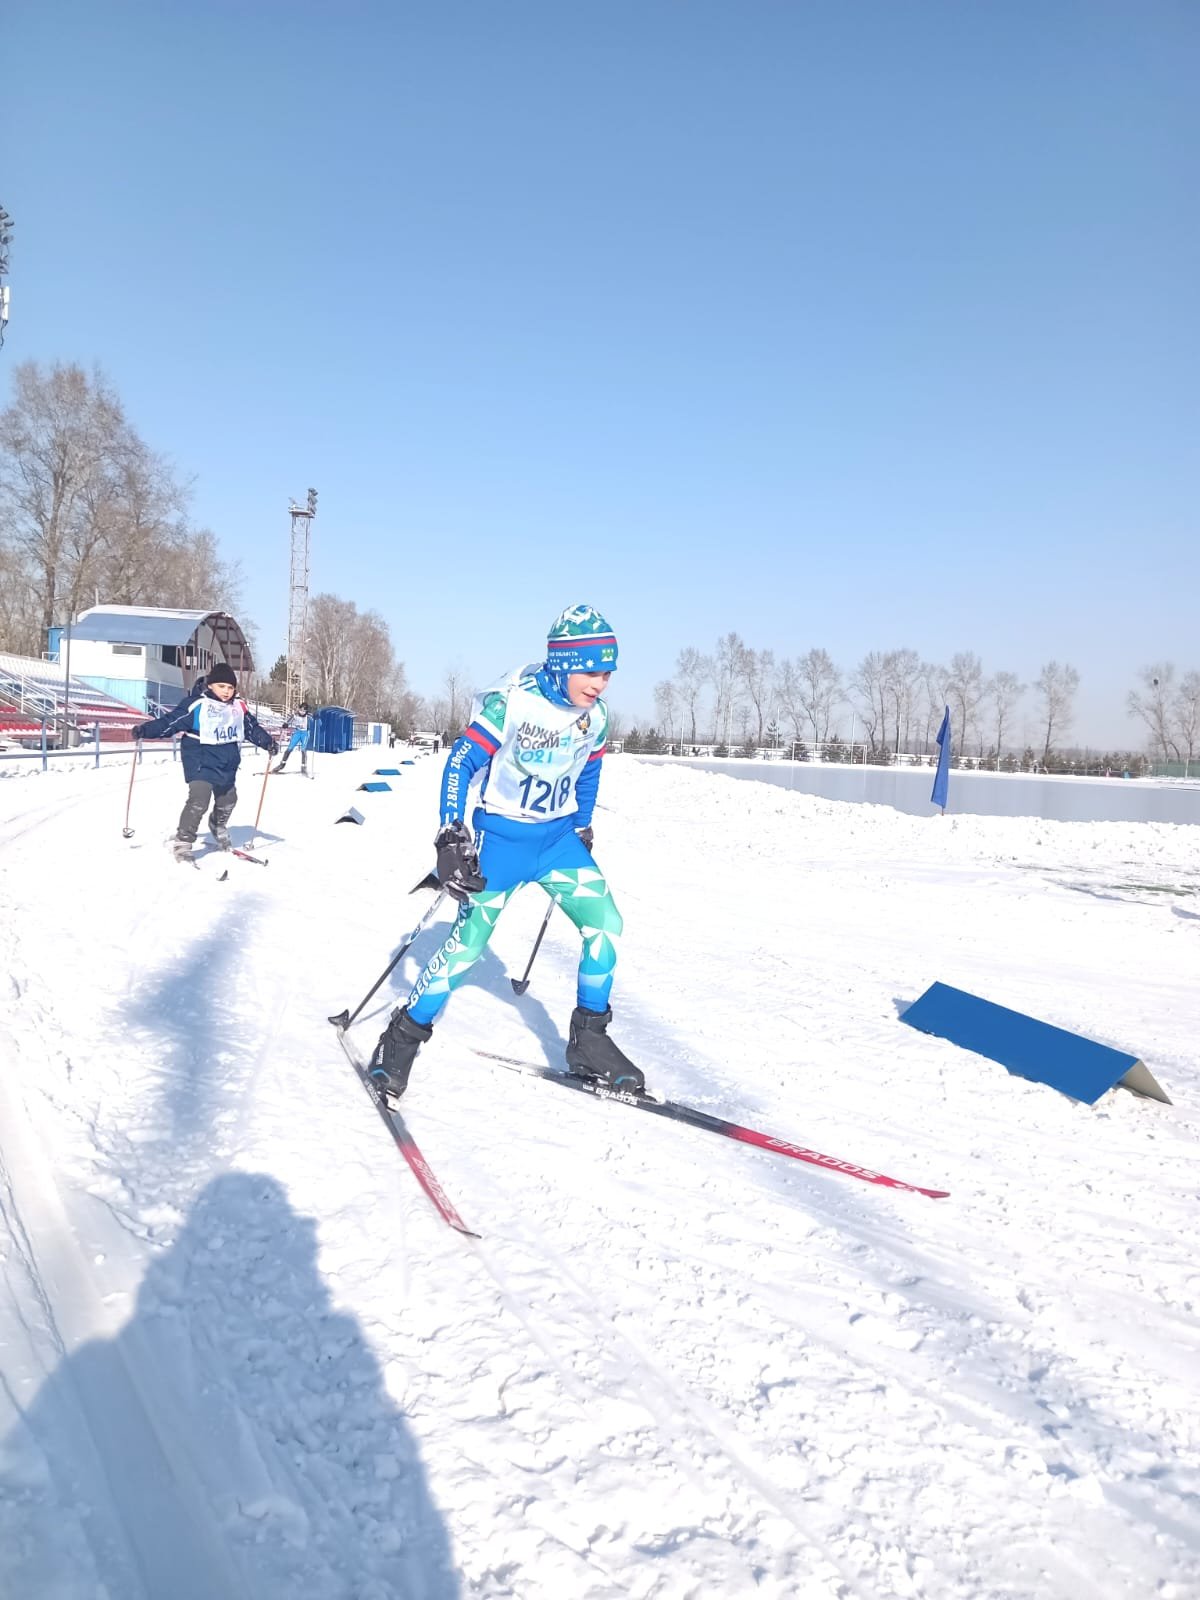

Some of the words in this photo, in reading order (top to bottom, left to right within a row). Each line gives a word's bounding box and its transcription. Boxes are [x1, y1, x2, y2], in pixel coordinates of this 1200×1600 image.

[214, 726, 238, 741] 1404
[450, 740, 472, 770] 28RUS
[446, 772, 460, 809] 28RUS
[765, 1138, 881, 1179] BRADOS
